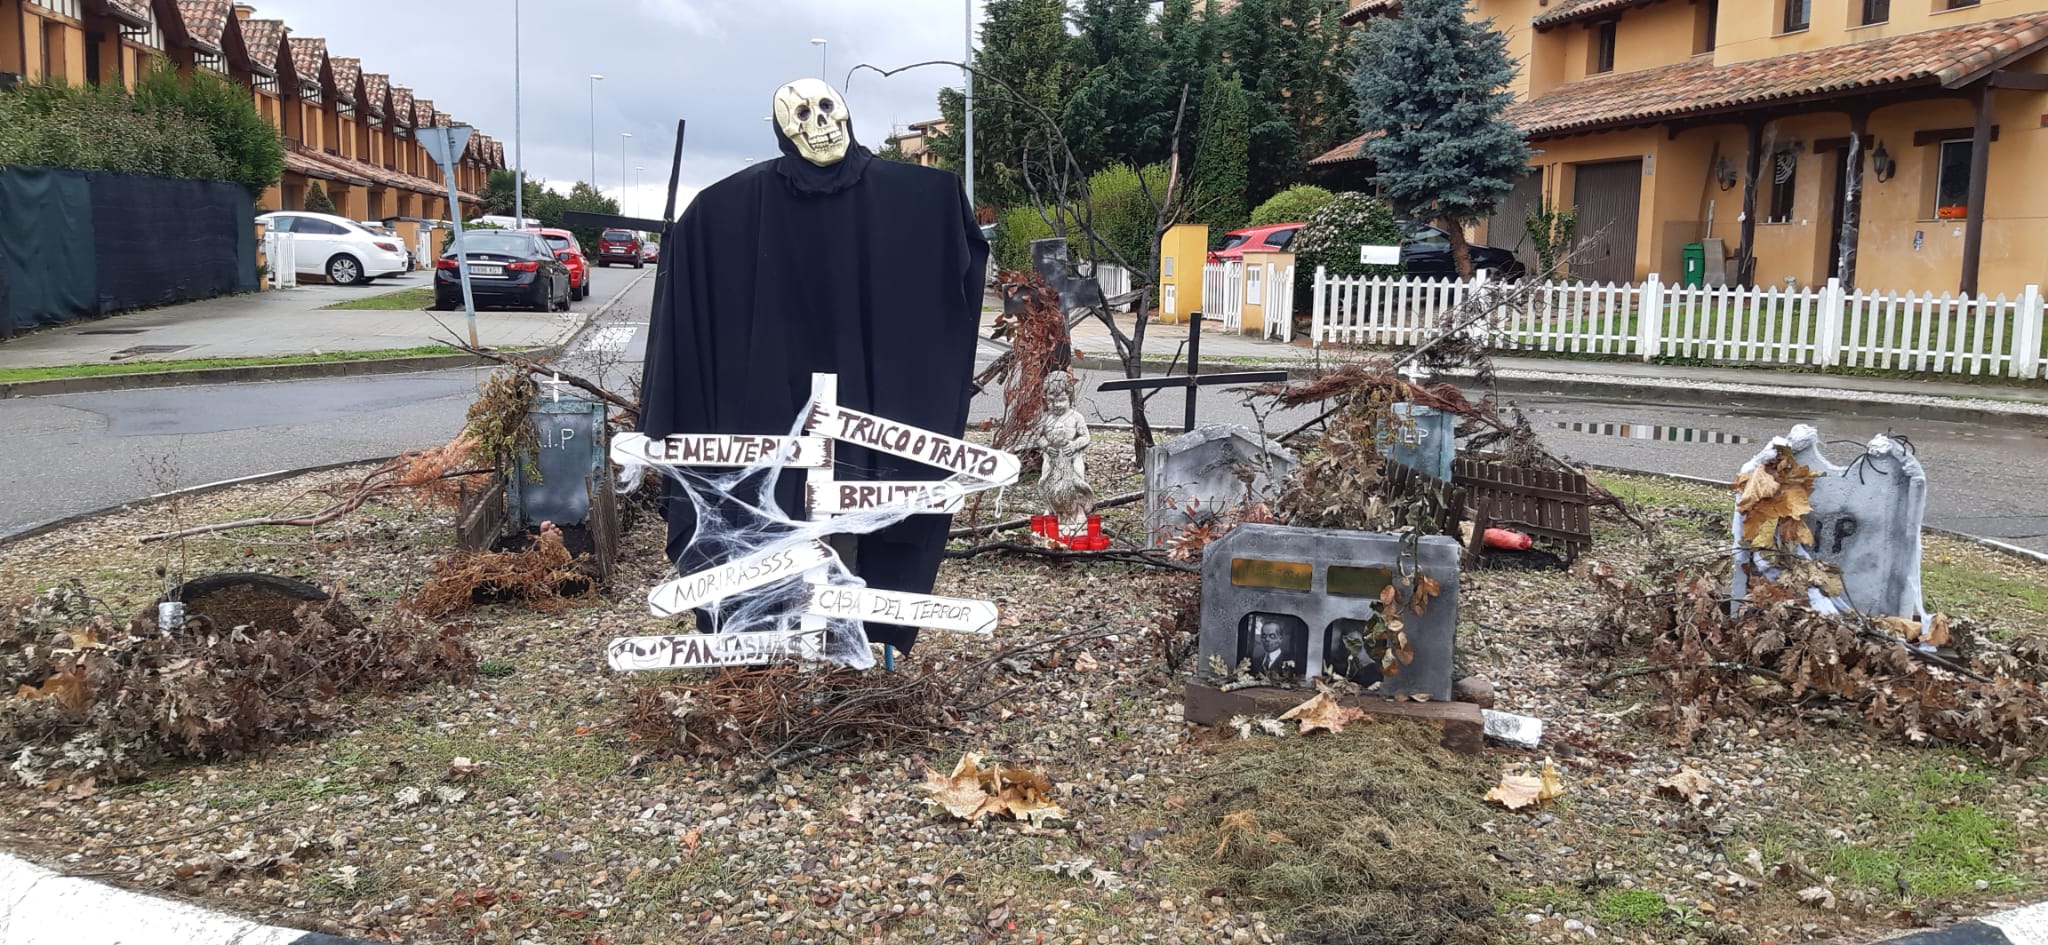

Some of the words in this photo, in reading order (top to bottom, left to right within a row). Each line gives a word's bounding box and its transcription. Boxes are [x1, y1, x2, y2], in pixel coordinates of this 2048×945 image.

[644, 436, 802, 463] CEMENTERIO
[837, 410, 911, 452] TRUCO
[912, 434, 927, 456] O
[928, 437, 998, 476] TRATO
[839, 484, 948, 510] BRUTAS
[818, 590, 861, 614] CASA
[871, 596, 905, 620] DEL
[910, 600, 972, 622] TERROR
